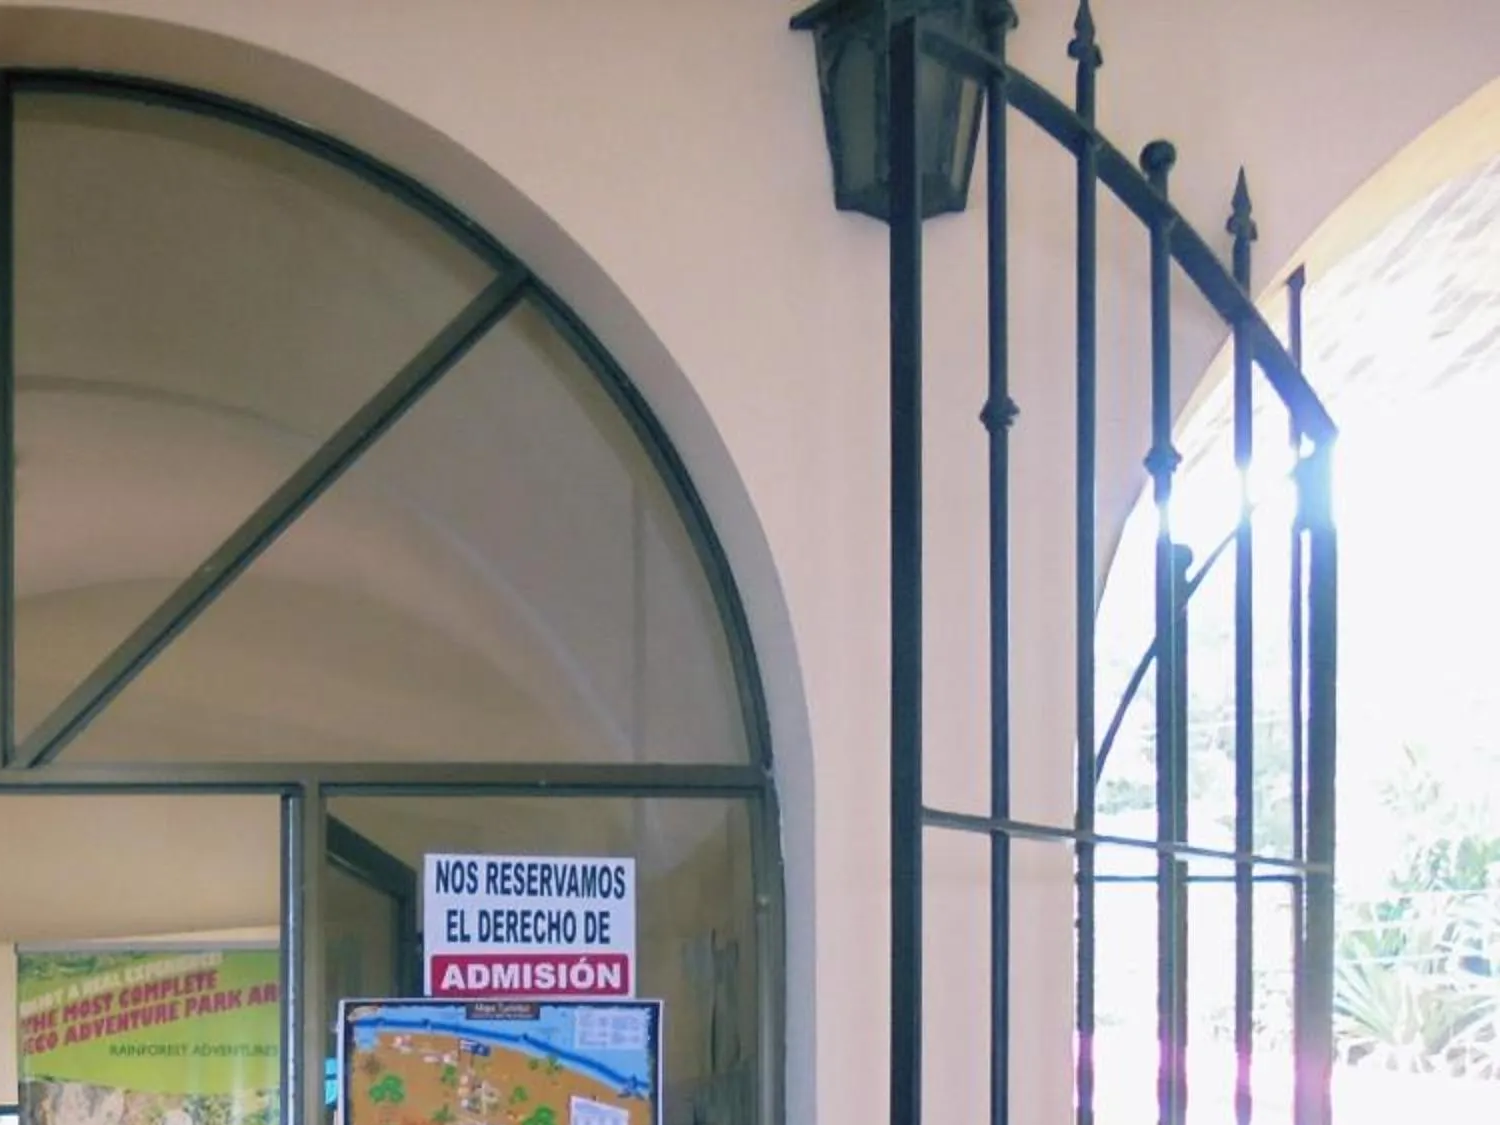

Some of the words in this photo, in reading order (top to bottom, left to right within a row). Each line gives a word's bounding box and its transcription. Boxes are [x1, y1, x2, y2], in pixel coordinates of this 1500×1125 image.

[435, 860, 478, 895] NOS
[486, 861, 626, 899] RESERVAMOS
[446, 909, 470, 943] EL
[478, 909, 577, 944] DERECHO
[584, 911, 611, 945] DE
[441, 957, 622, 990] ADMISIÓN
[22, 1009, 57, 1033] THE
[63, 992, 113, 1023] MOST
[119, 969, 218, 1008] COMPLETE
[64, 1001, 180, 1046] ADVENTURE
[184, 989, 242, 1018] PARK
[248, 982, 280, 1007] AR
